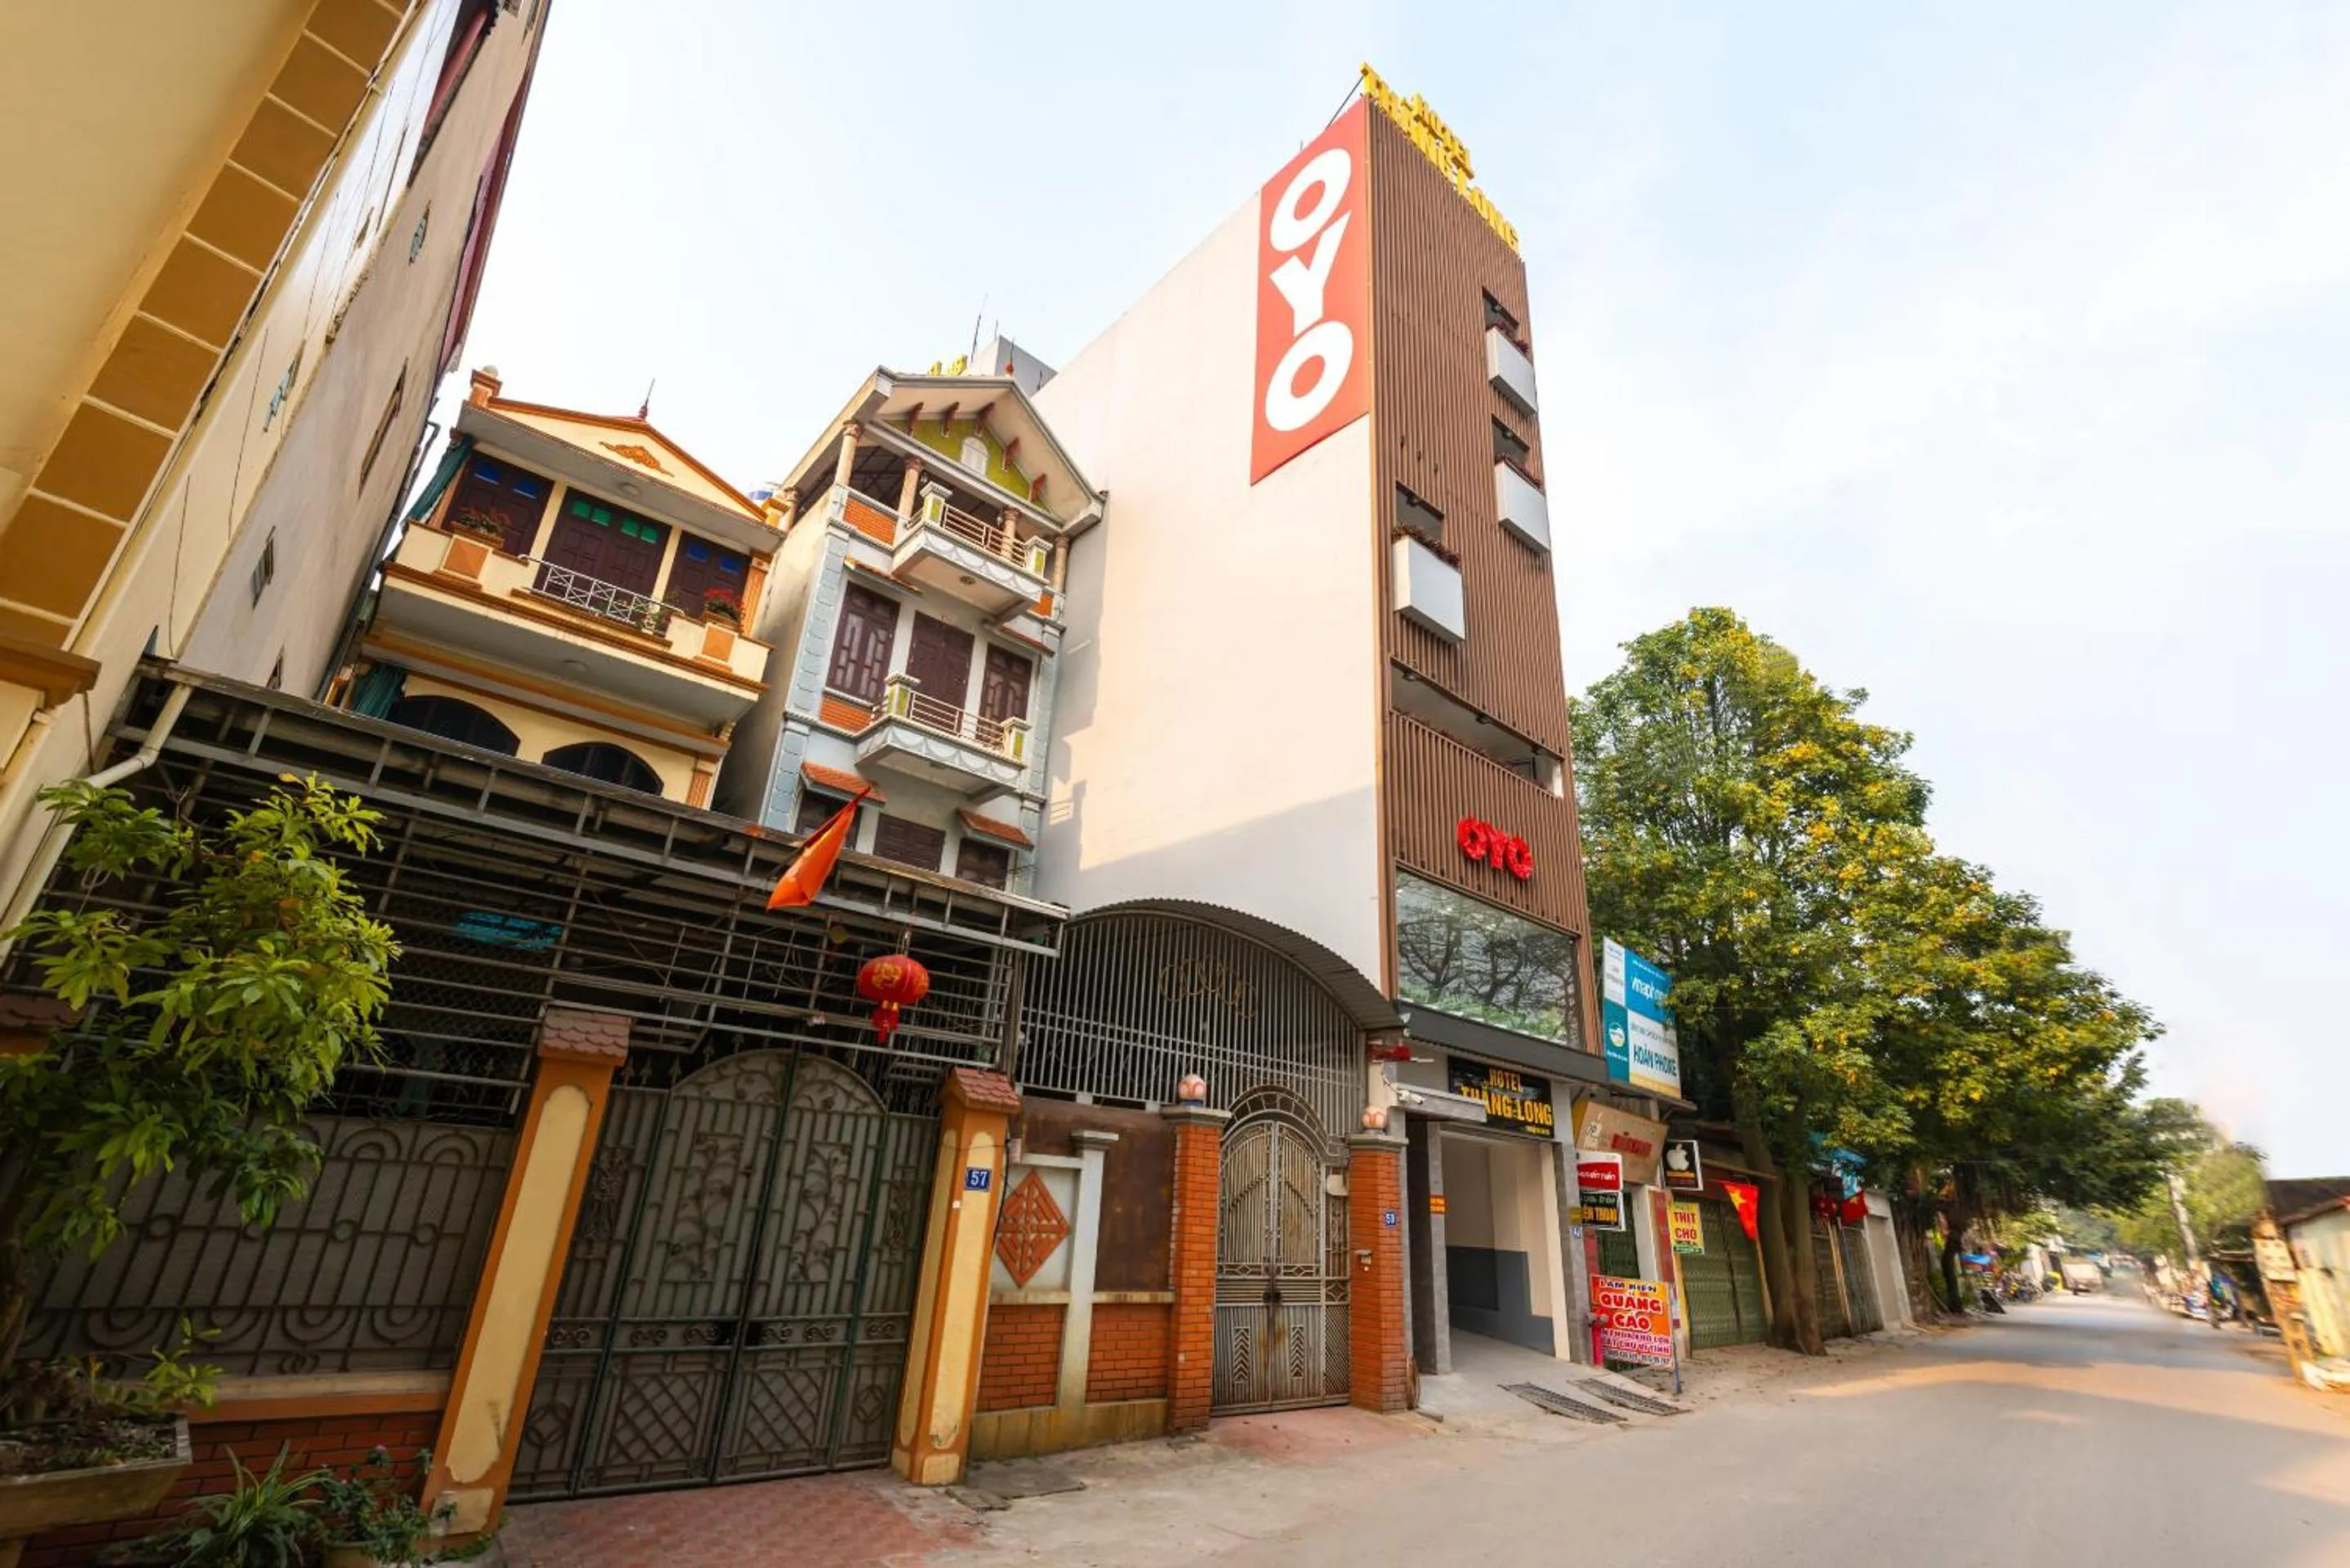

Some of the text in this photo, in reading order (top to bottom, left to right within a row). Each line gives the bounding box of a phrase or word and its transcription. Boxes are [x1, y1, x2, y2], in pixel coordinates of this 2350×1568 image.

[1265, 147, 1353, 432] OYO
[1457, 814, 1534, 880] OYO
[1489, 1067, 1523, 1094] HOTEL
[1516, 1098, 1554, 1126] LONG
[970, 1170, 988, 1187] 57
